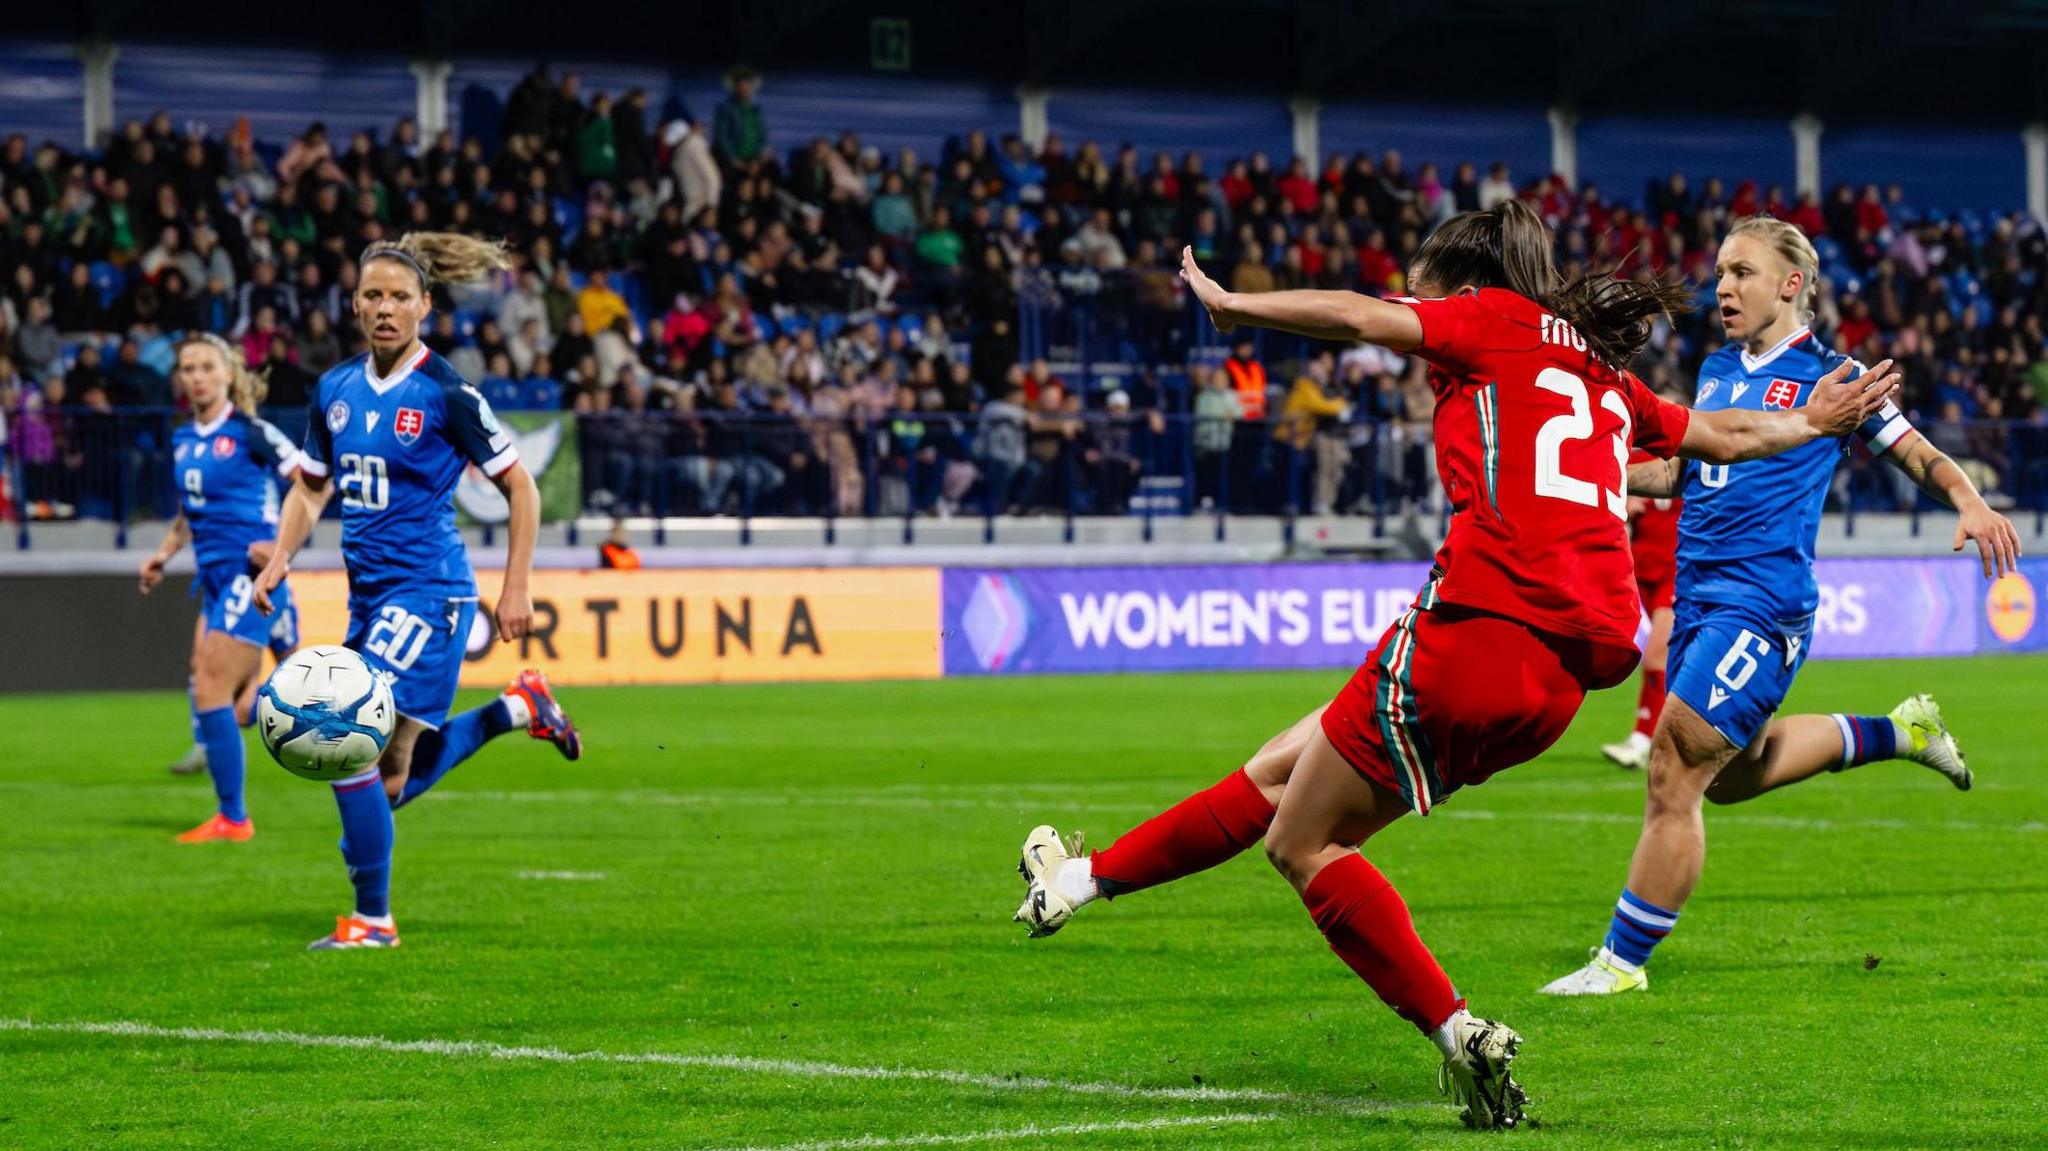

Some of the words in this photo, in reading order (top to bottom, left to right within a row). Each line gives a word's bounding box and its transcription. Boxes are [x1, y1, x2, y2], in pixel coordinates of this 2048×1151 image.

[184, 468, 206, 508] 9
[340, 453, 390, 511] 20
[225, 573, 253, 617] 9
[1060, 588, 1310, 649] WOMEN'S
[364, 605, 433, 671] 20
[1715, 628, 1771, 691] 6
